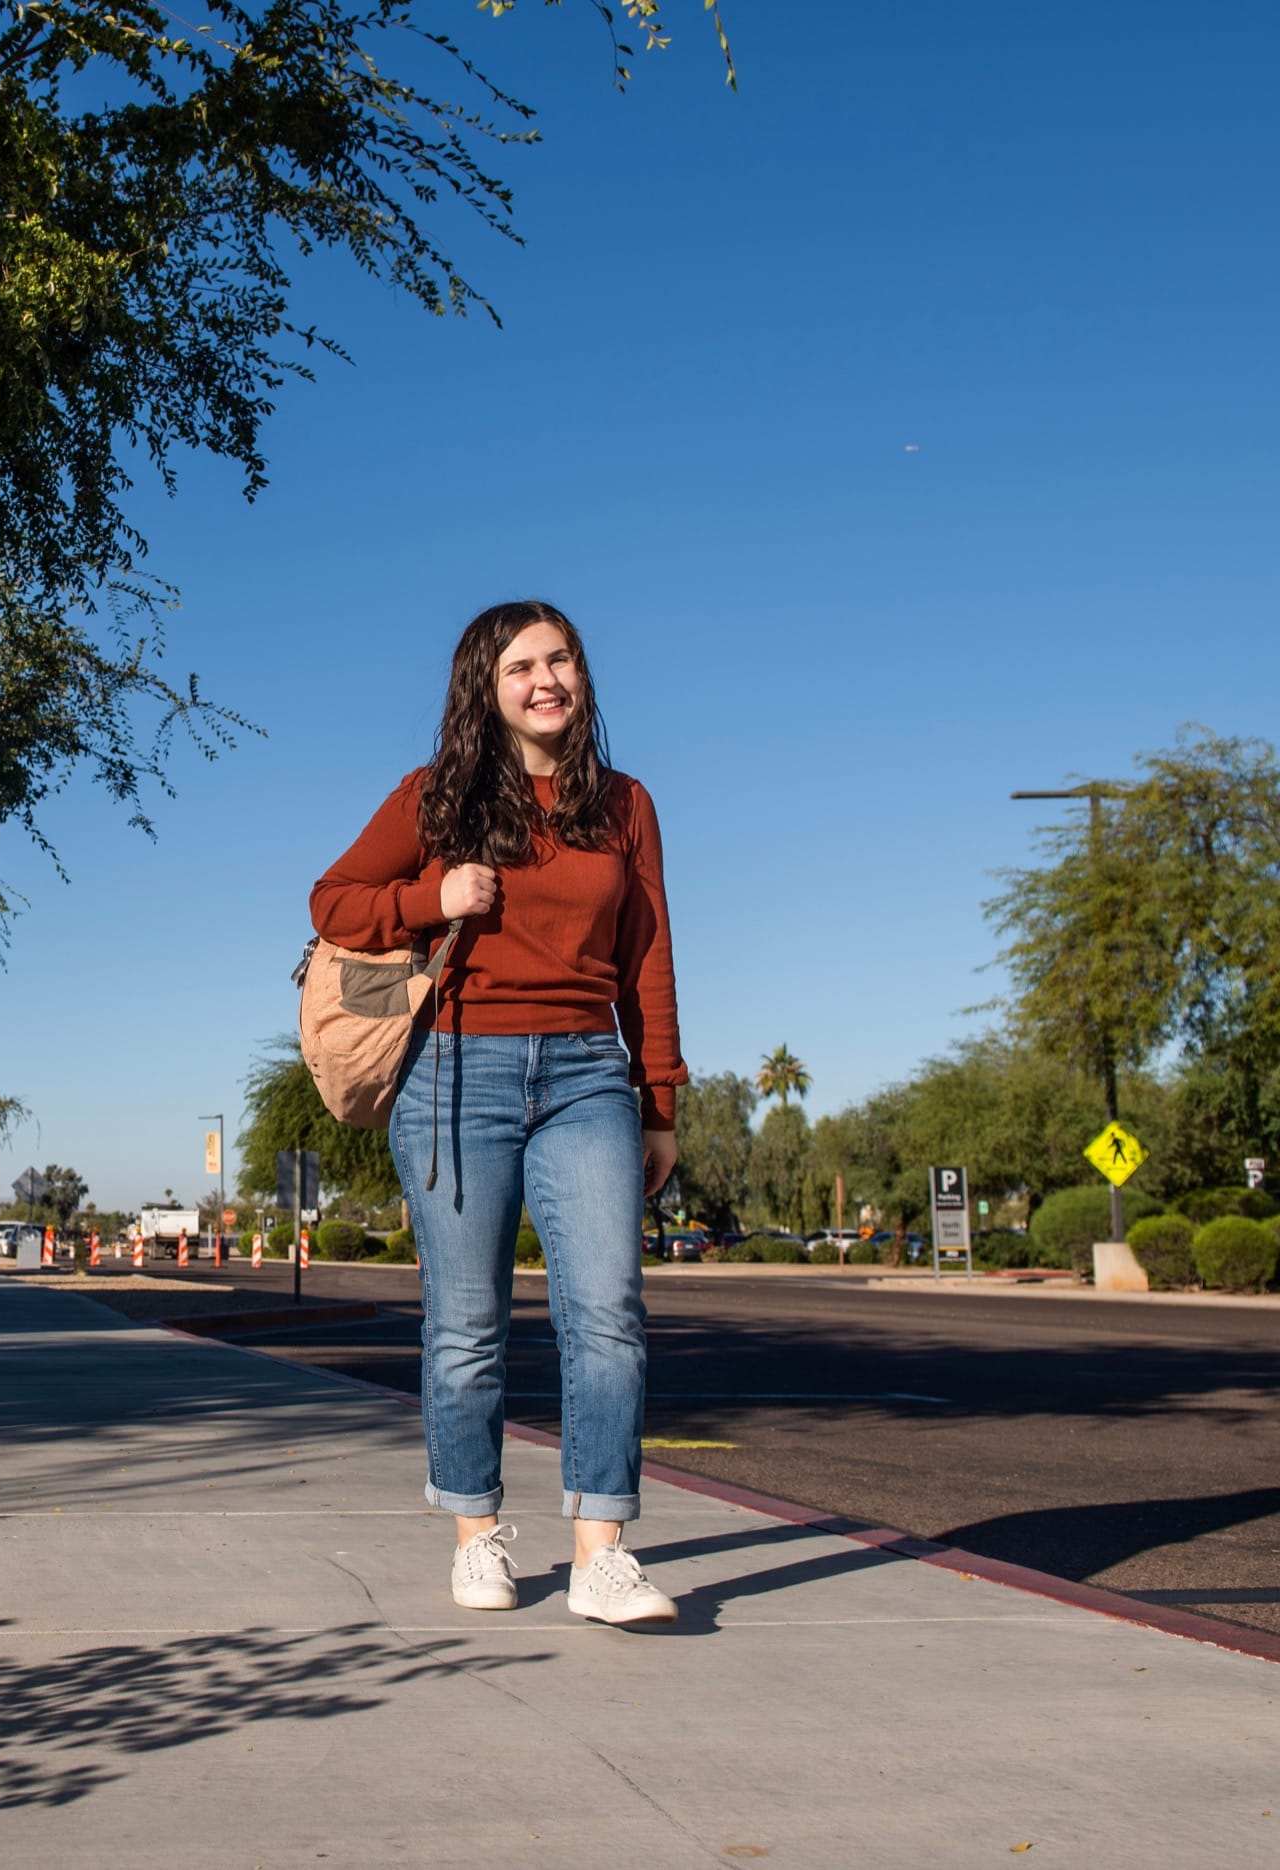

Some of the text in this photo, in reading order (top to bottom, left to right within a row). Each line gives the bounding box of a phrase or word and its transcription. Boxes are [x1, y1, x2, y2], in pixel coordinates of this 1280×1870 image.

[942, 1170, 958, 1192] P
[1248, 1170, 1263, 1189] P
[266, 1217, 274, 1227] P
